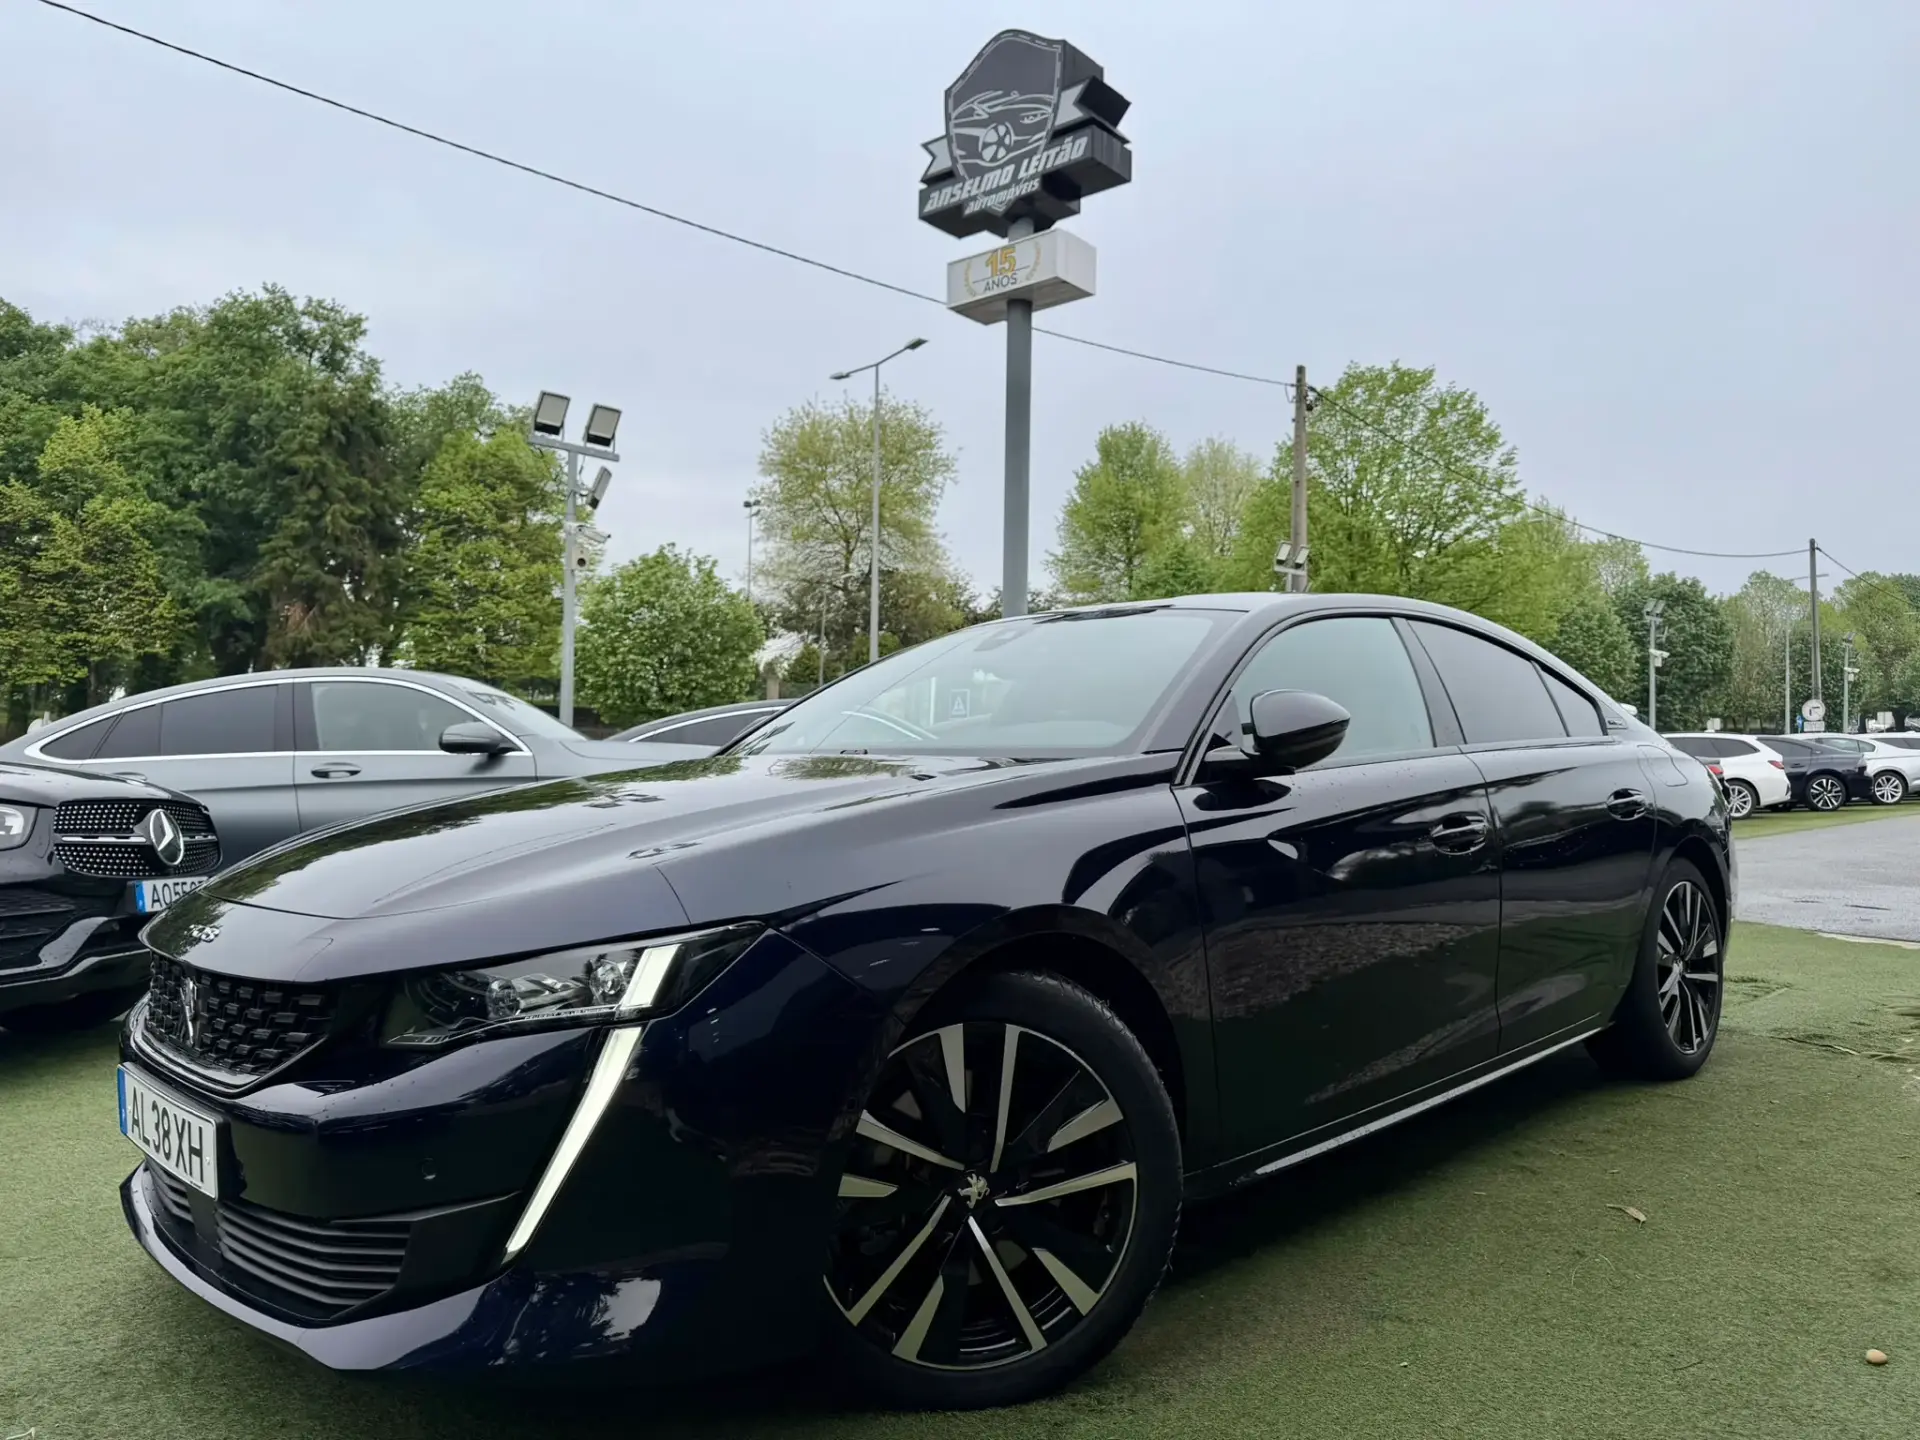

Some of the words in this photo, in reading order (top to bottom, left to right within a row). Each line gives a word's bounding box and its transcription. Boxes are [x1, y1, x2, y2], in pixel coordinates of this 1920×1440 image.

[923, 164, 1016, 213] ANSELMO
[1018, 136, 1089, 179] LEITÃO
[985, 247, 1017, 278] 15
[984, 273, 1018, 292] ANOS
